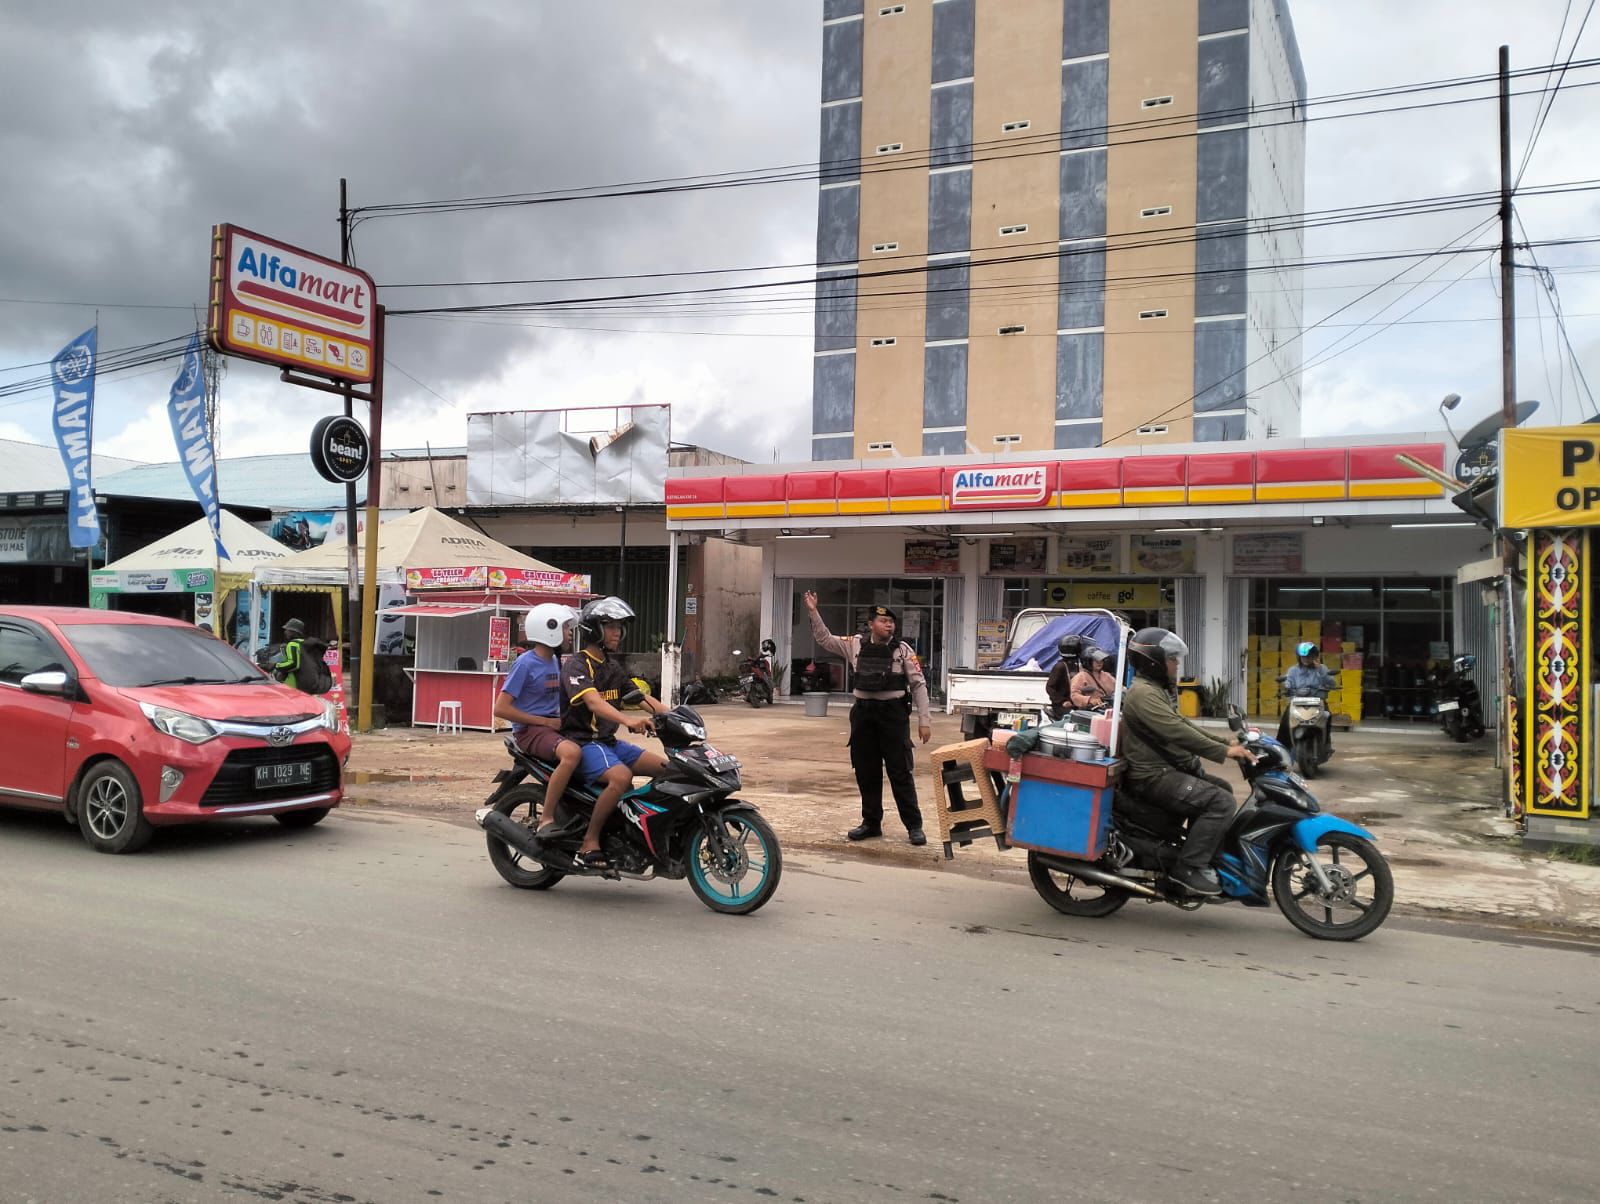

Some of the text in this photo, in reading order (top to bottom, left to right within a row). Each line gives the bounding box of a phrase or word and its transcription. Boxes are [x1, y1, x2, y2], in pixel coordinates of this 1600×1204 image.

[237, 246, 366, 309] Alfamart
[329, 437, 363, 460] bean!
[1562, 440, 1600, 477] P
[956, 470, 1043, 488] Alfamart
[9, 542, 25, 552] MAS
[443, 568, 463, 576] TELER
[537, 571, 561, 580] TELER
[1087, 588, 1135, 604] coffee go!
[257, 767, 268, 779] KH
[274, 765, 293, 778] 1029
